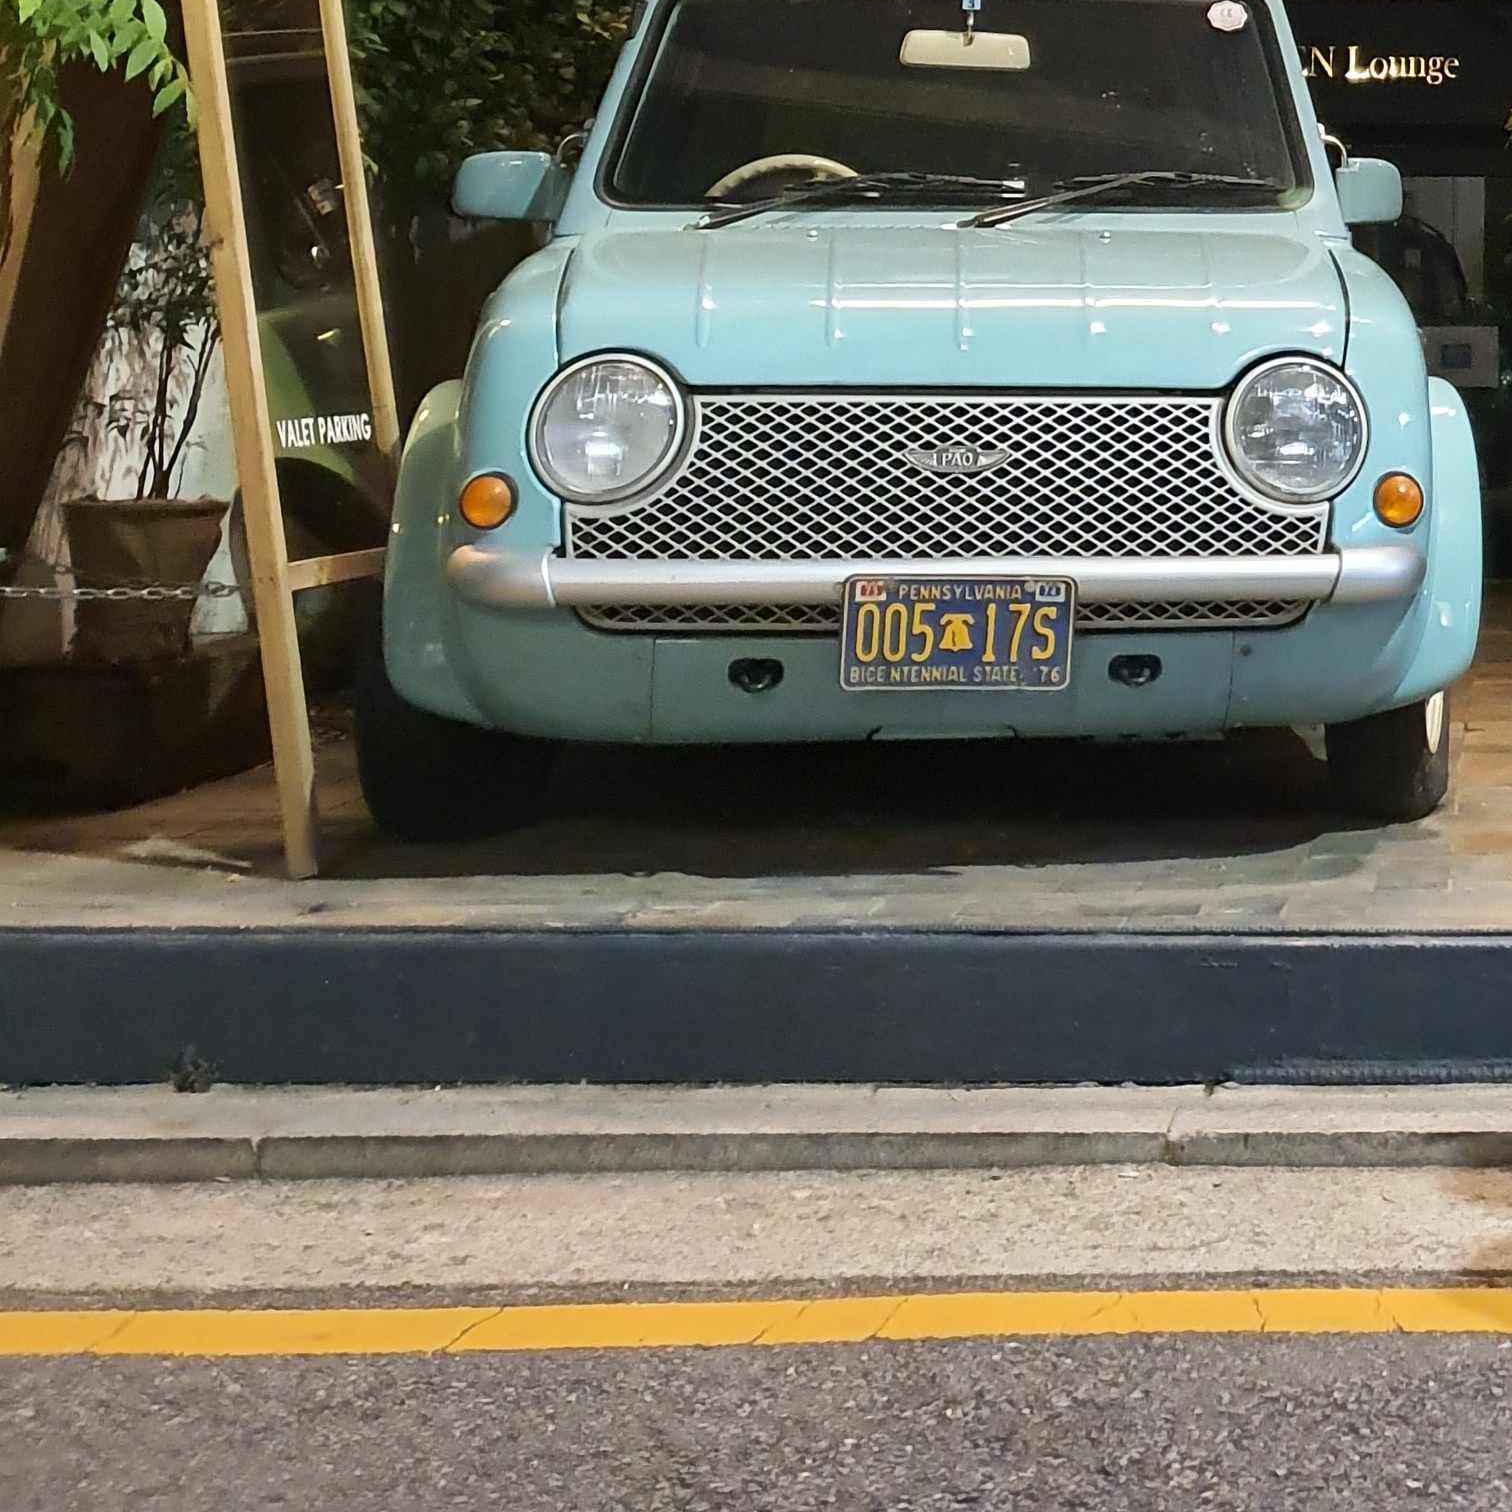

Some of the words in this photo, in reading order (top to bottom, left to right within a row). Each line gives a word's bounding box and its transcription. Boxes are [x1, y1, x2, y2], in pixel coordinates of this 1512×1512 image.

[1345, 45, 1460, 85] Lounge
[276, 418, 315, 448] VALET
[317, 413, 372, 445] PARKING
[942, 452, 973, 467] PAO
[898, 583, 1022, 600] PENNSYLVANIA
[855, 602, 936, 663] 005
[981, 603, 1057, 663] 17S
[850, 665, 967, 683] BICENTENNIAL
